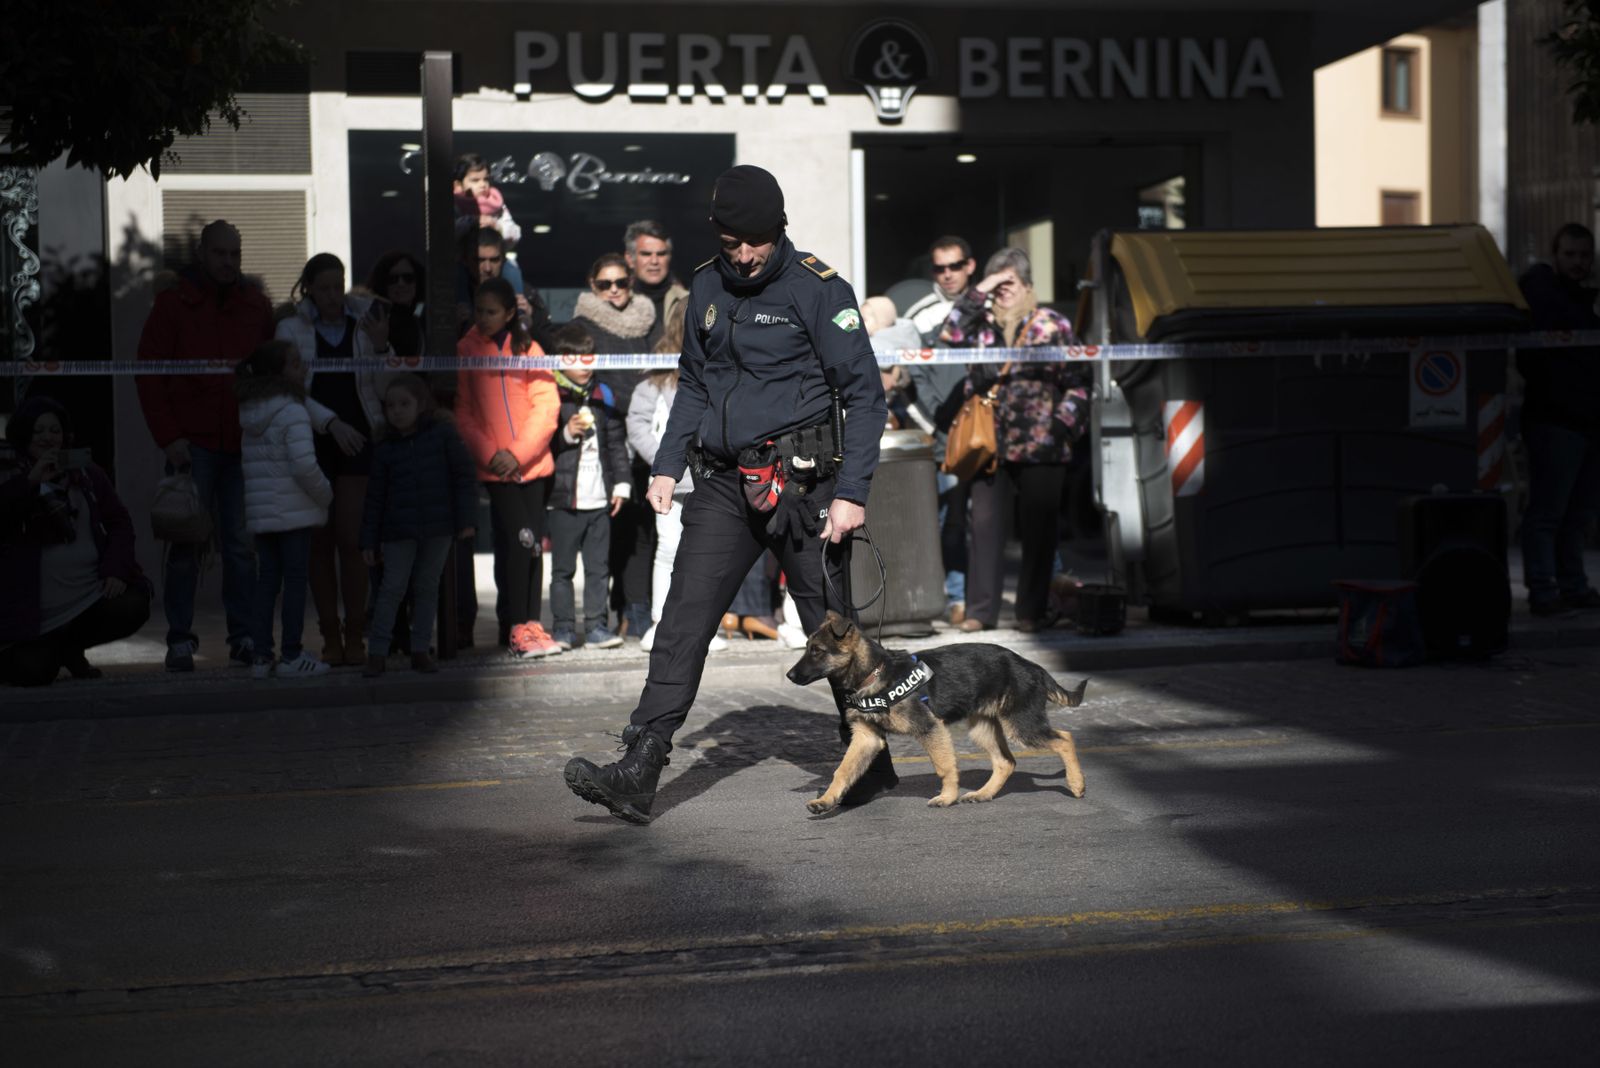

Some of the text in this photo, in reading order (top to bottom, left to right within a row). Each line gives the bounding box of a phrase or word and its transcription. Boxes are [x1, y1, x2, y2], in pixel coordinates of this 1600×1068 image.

[513, 31, 1284, 99] PUERTA & BERNINA
[868, 697, 888, 708] LEE
